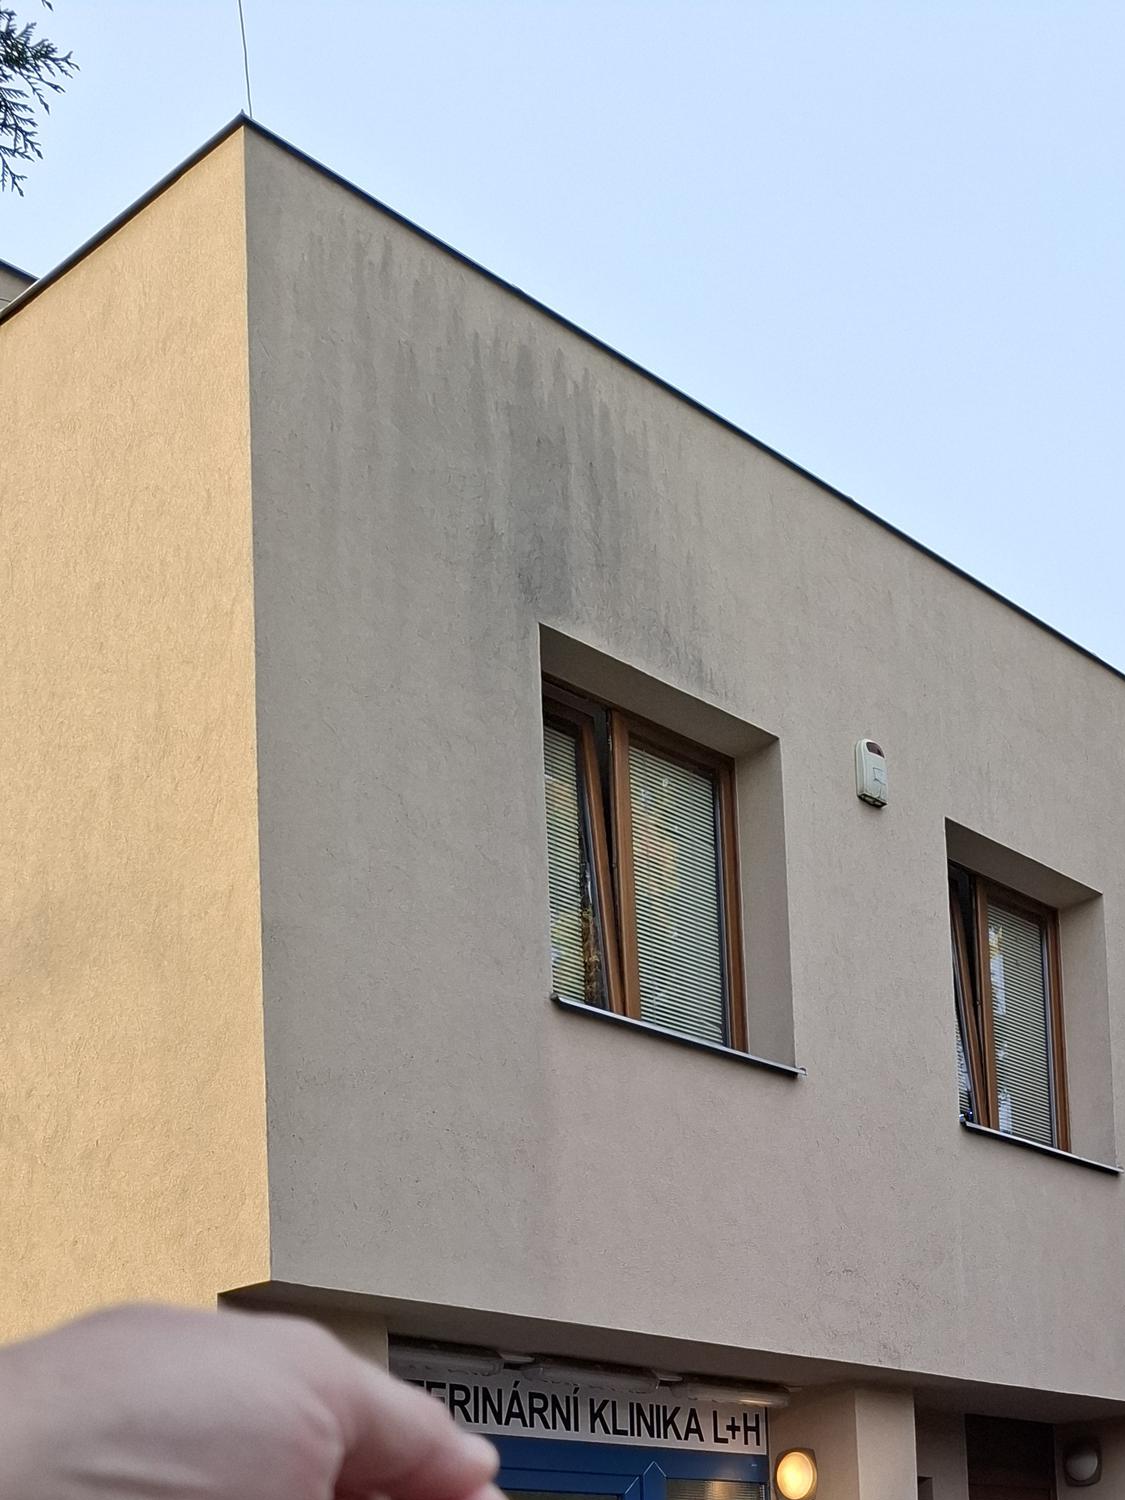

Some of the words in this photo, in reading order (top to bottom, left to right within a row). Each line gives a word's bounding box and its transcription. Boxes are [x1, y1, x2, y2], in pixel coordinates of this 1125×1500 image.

[403, 1378, 580, 1433] RINÁRNÍ
[589, 1397, 705, 1442] KLINIKA
[712, 1410, 761, 1446] L+H
